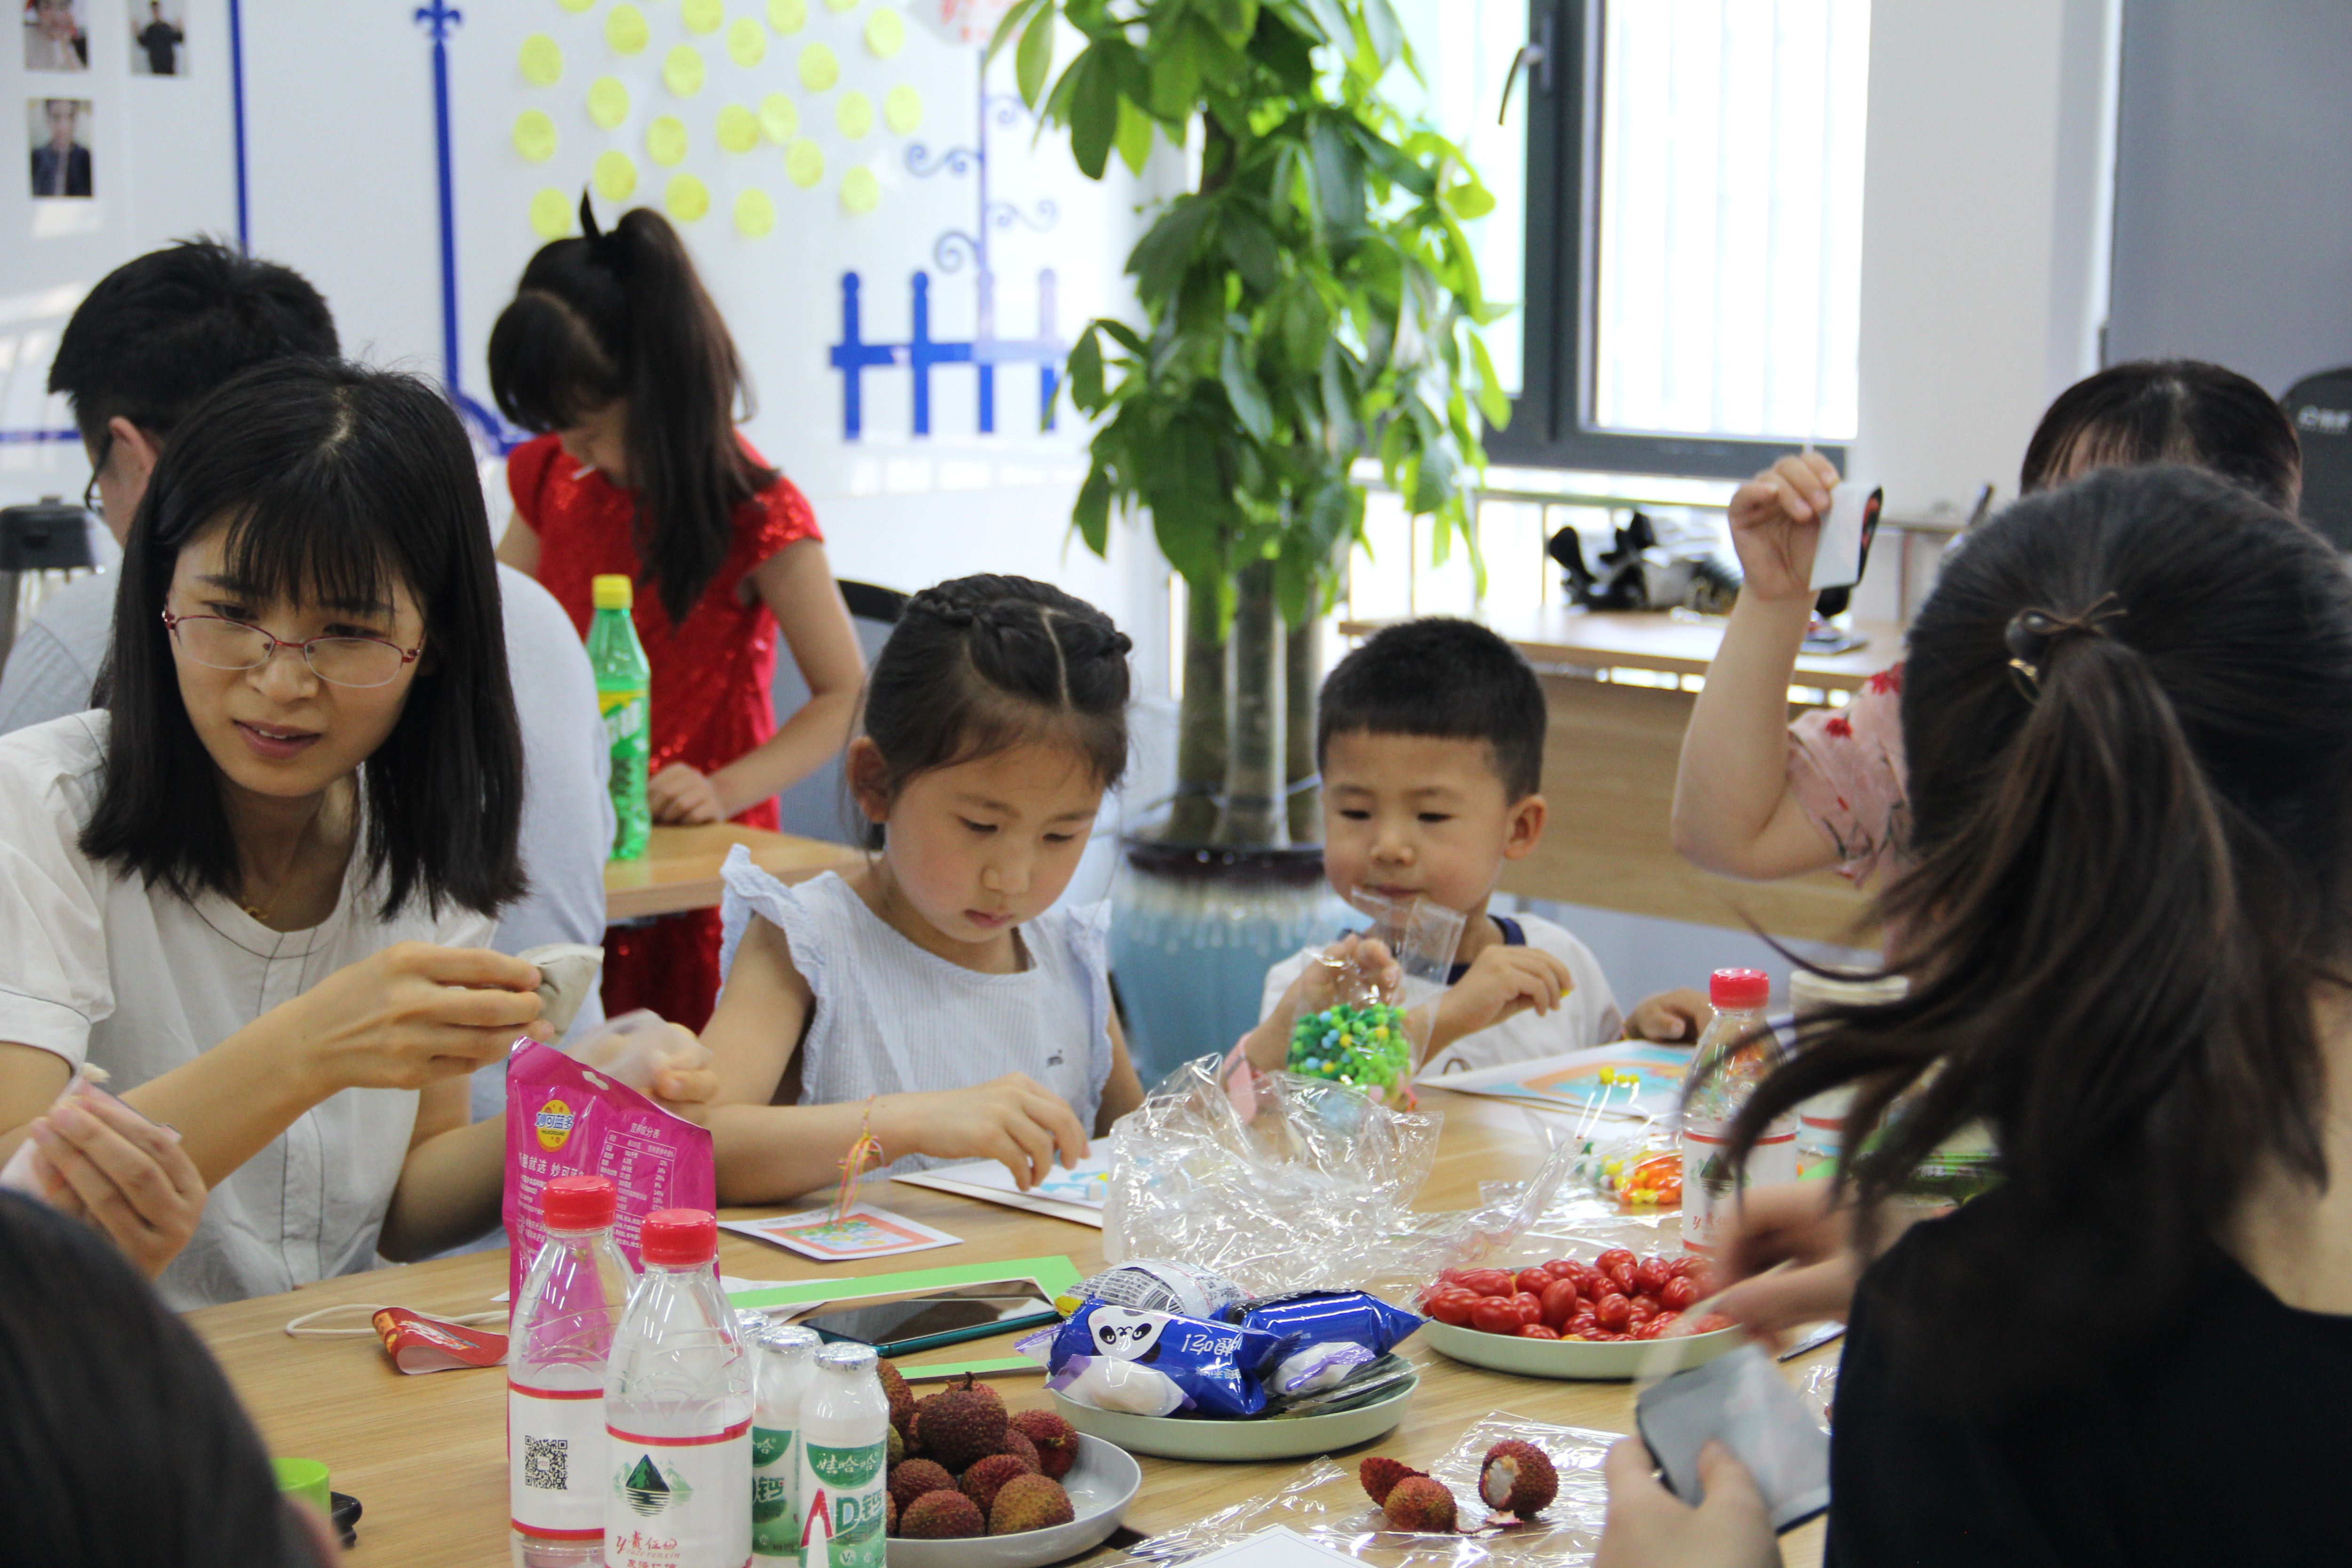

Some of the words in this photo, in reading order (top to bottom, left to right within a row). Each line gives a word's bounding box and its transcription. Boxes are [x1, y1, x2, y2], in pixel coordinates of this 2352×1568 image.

[534, 1112, 574, 1130] 妙可蓝多
[817, 1454, 876, 1474] 娃哈哈
